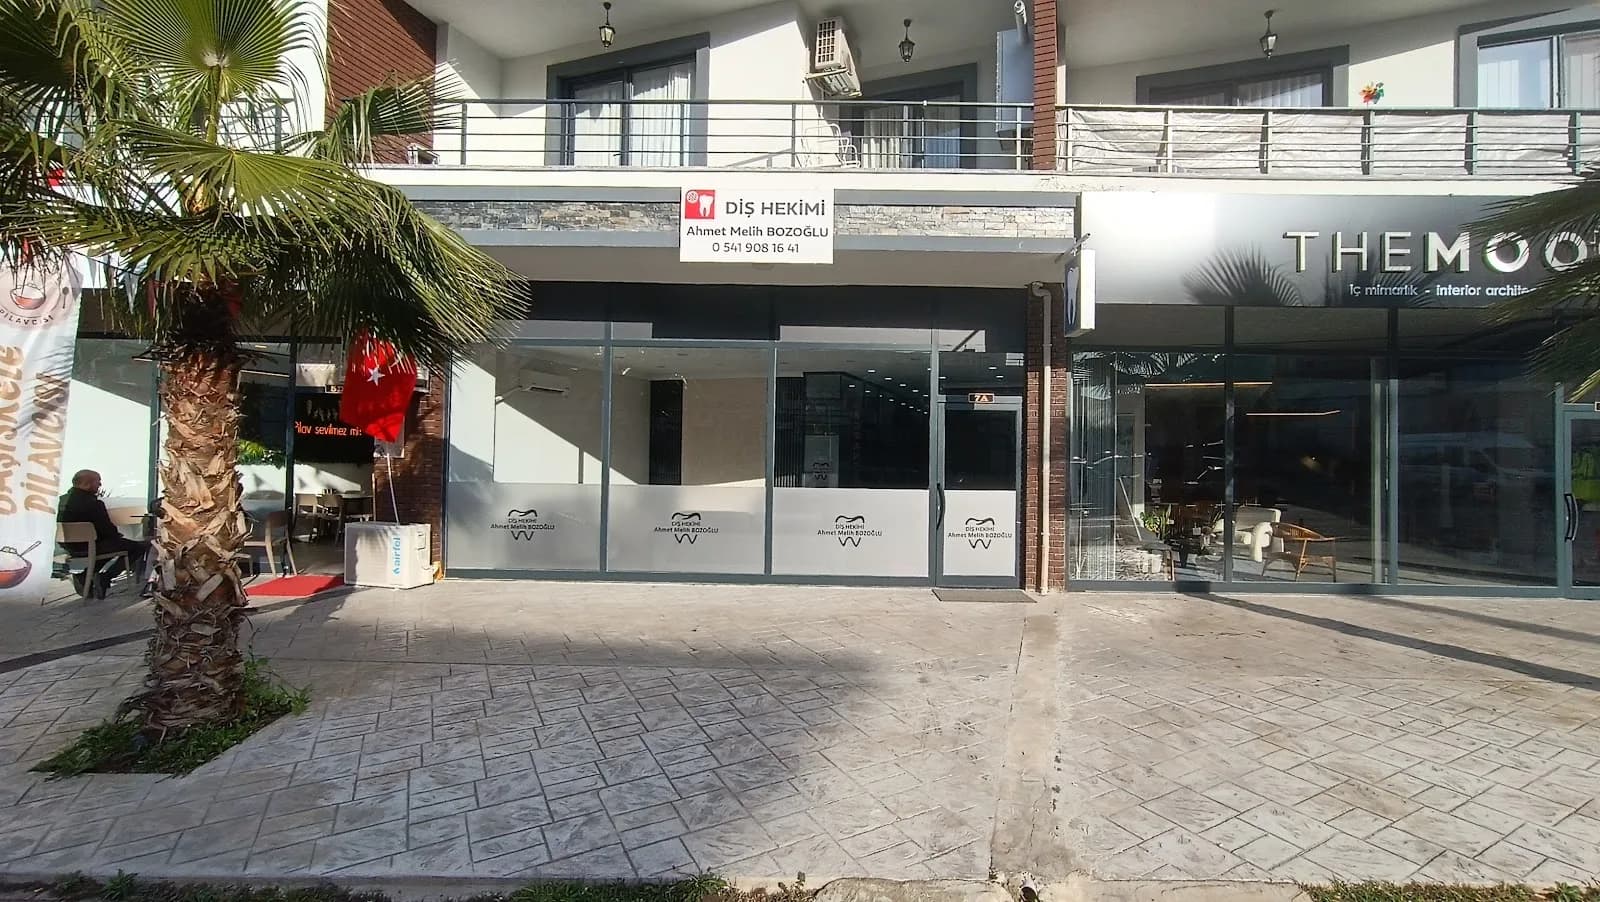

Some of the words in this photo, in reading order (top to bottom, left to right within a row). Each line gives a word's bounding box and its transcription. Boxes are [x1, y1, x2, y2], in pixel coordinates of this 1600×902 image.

[726, 198, 755, 218] DİŞ
[761, 199, 825, 216] HEKİMİ
[686, 226, 727, 236] Ahmet
[730, 225, 763, 237] Melih
[767, 225, 829, 238] BOZOĞLU
[712, 242, 720, 252] 0
[724, 242, 742, 252] 541
[745, 243, 769, 253] 908
[772, 243, 784, 253] 16
[787, 243, 799, 253] 41
[1436, 284, 1482, 297] interior
[315, 423, 347, 436] sevilmez
